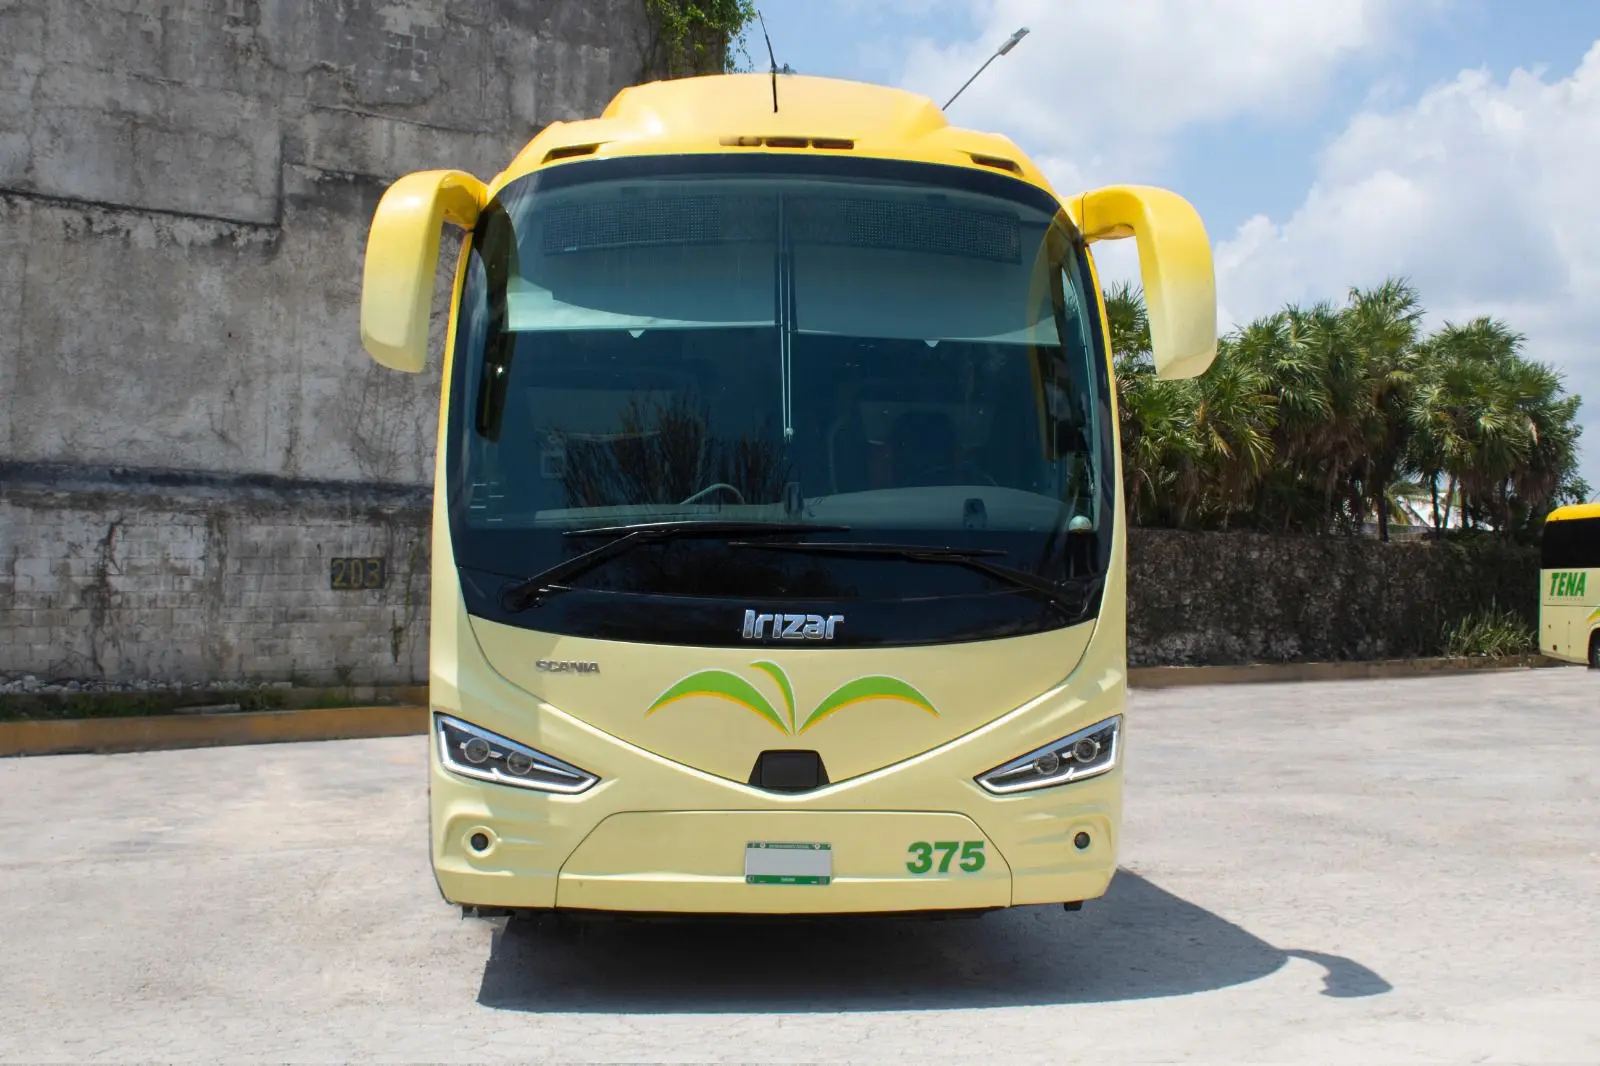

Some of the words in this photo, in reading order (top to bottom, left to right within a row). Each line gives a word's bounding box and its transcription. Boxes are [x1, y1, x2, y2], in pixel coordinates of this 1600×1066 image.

[332, 559, 380, 588] 203
[1550, 572, 1586, 596] TENA
[742, 609, 844, 639] Irizar
[536, 659, 600, 673] SCANIA
[906, 841, 986, 874] 375
